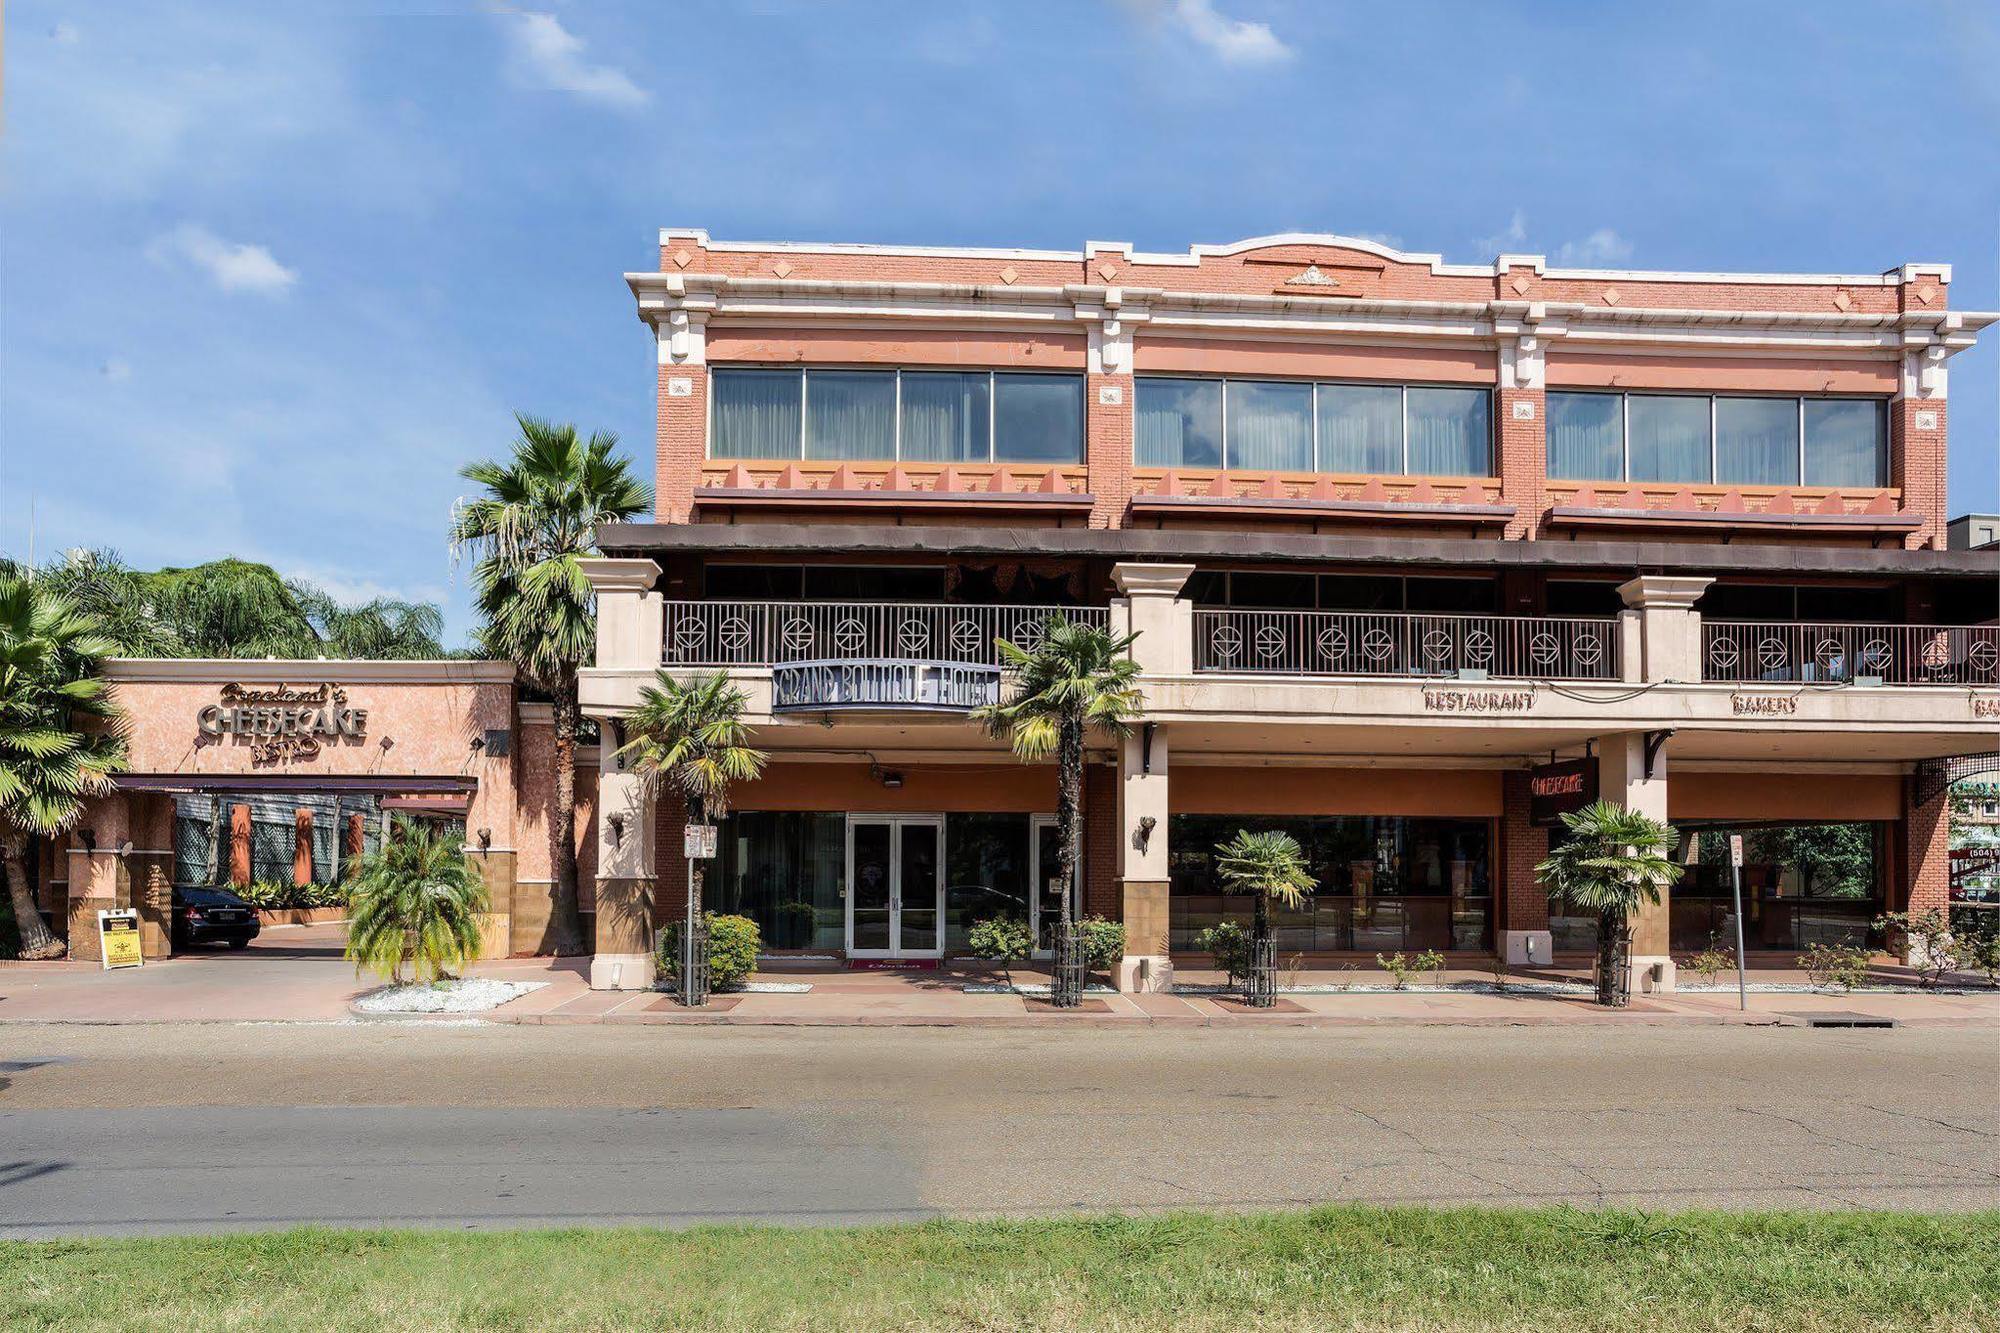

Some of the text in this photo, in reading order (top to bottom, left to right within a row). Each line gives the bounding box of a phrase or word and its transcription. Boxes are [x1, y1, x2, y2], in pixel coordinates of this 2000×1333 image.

[220, 682, 347, 707] Copeland's
[779, 666, 835, 704] GRAND
[843, 664, 931, 704] BOUTIQUE
[1424, 690, 1534, 712] RESTAURANT
[1732, 695, 1798, 715] BAKERY
[197, 704, 368, 737] CHEESECAKE
[251, 737, 321, 763] BISTRO
